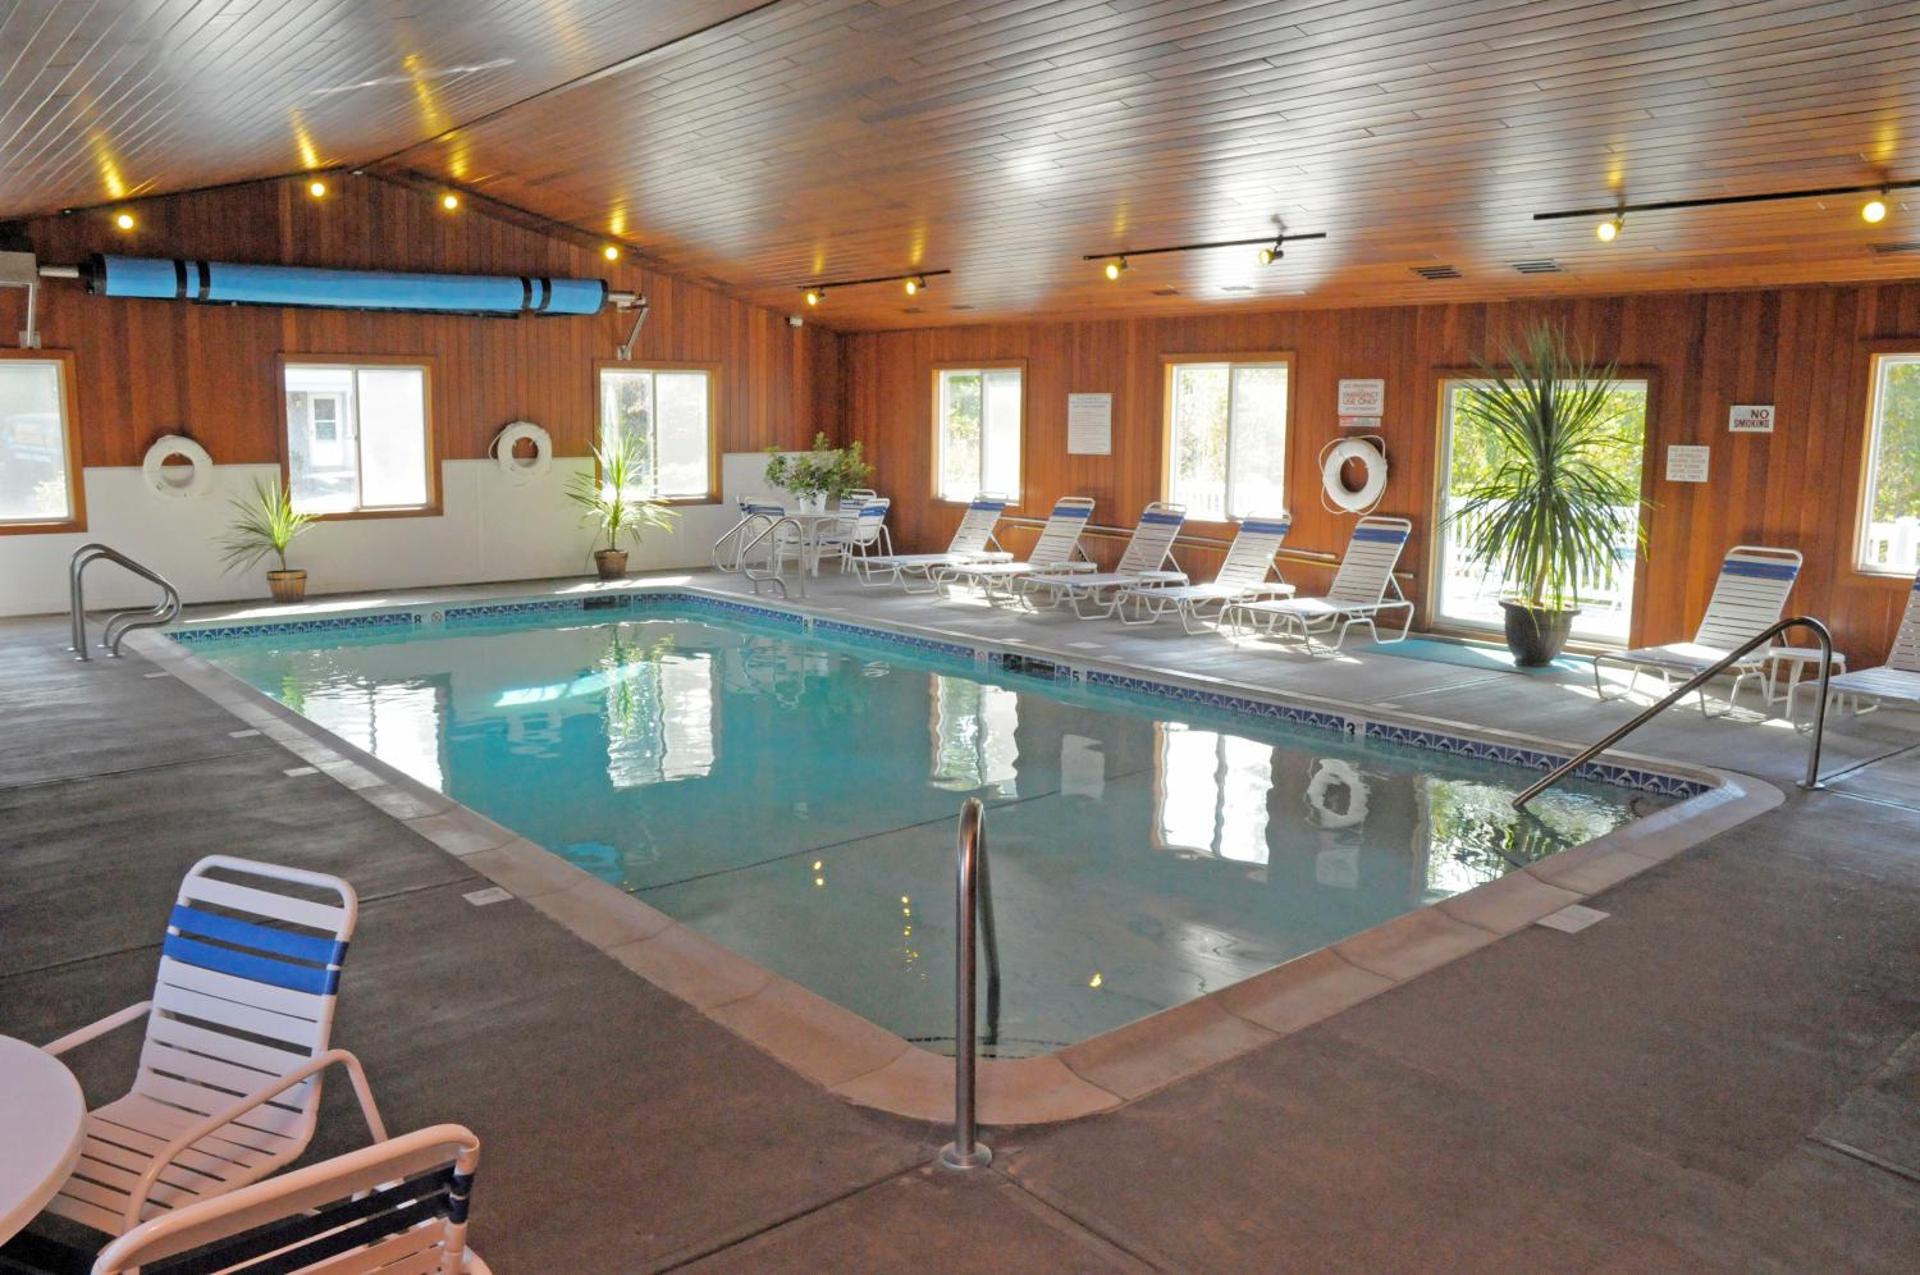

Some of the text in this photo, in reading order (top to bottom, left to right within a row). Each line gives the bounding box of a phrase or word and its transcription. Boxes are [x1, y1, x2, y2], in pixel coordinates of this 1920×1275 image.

[1750, 409, 1769, 420] NO
[1733, 419, 1770, 428] SMOKING
[1072, 670, 1080, 682] 5
[1346, 722, 1356, 735] 3
